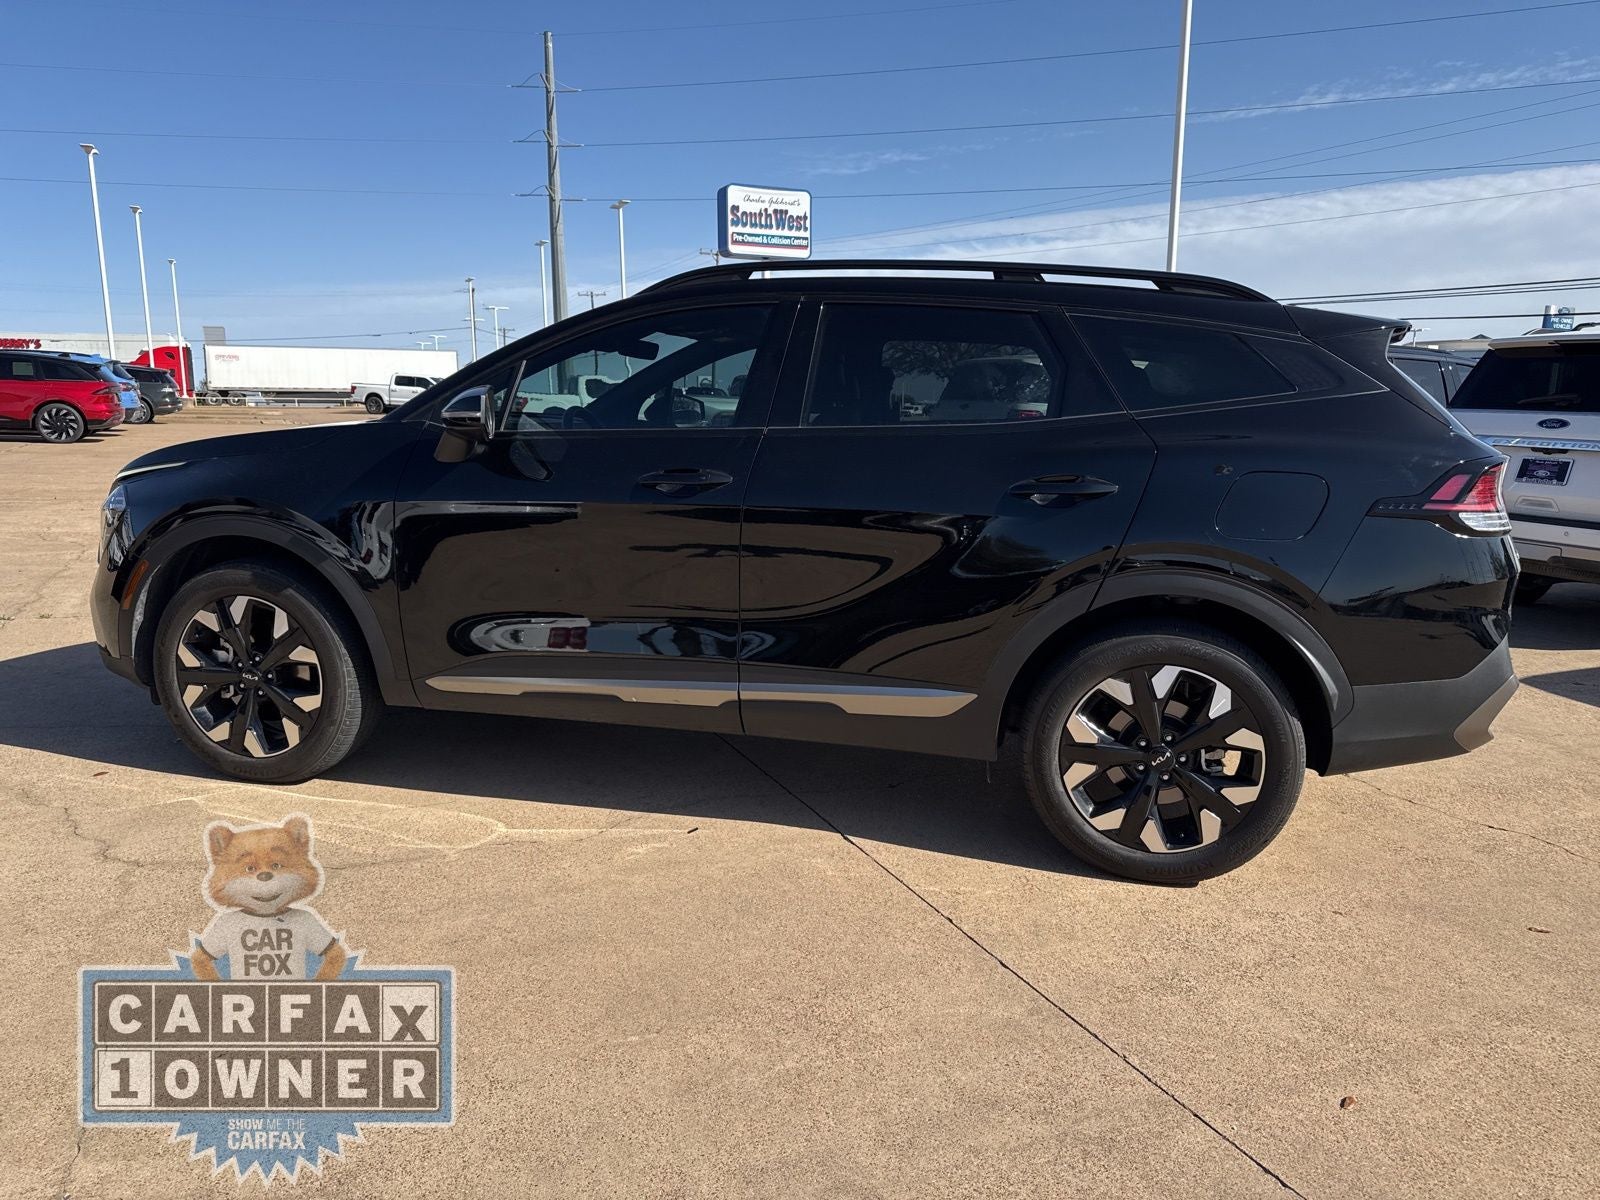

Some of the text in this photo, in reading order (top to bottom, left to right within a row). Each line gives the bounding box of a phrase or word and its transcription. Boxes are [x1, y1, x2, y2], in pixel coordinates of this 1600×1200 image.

[730, 204, 809, 232] SouthWest
[733, 233, 808, 246] Pre-Owned & Collision Center
[0, 338, 42, 350] ERRY'S
